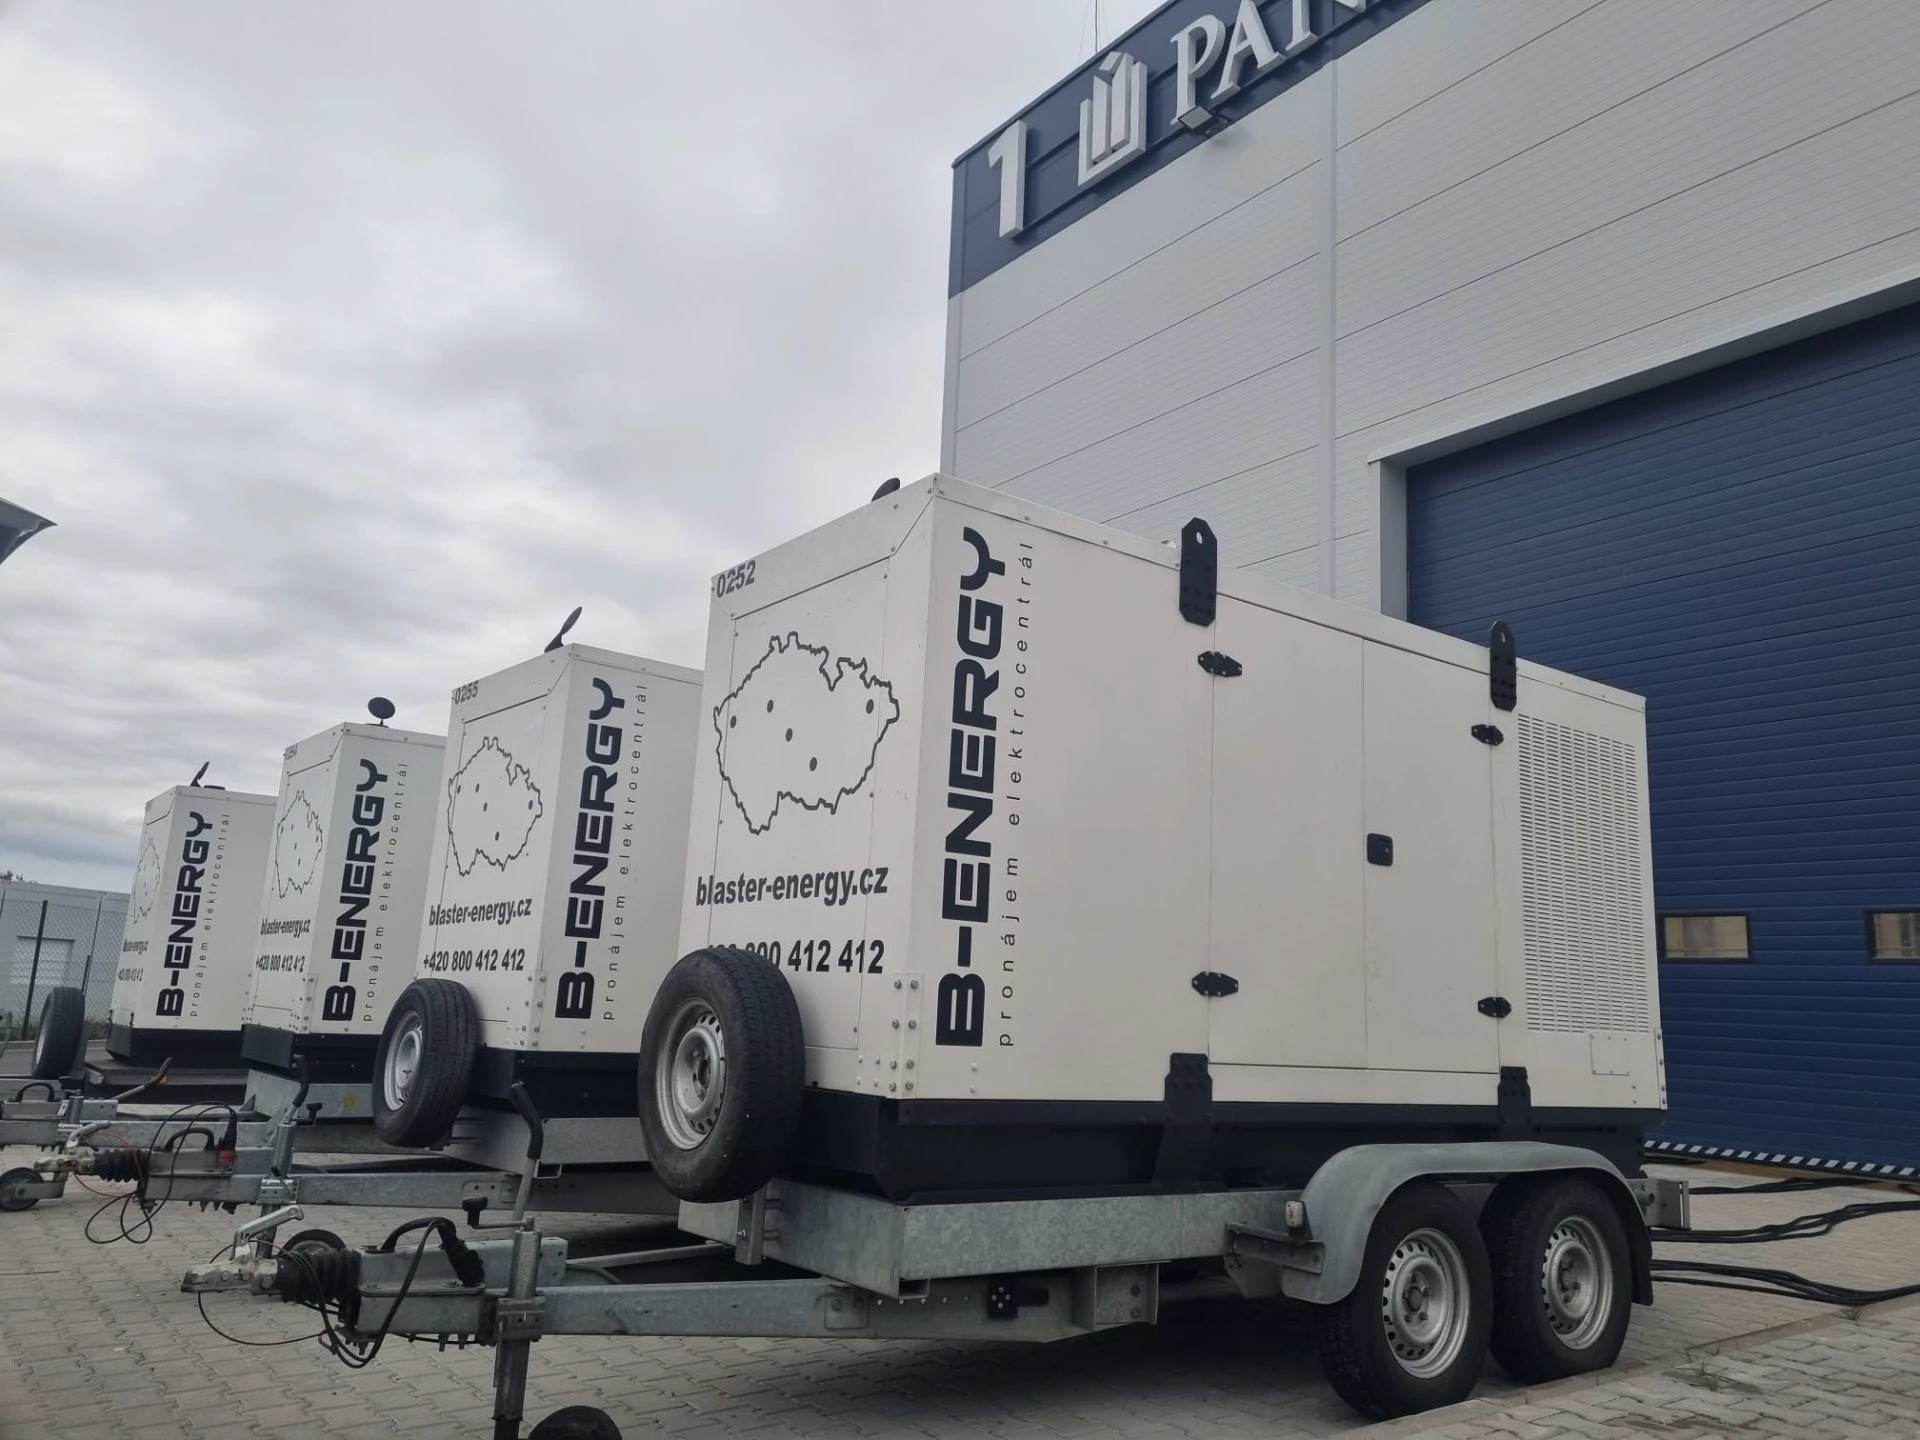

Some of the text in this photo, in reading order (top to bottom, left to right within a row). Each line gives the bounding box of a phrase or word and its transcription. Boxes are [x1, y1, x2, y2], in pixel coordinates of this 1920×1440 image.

[716, 559, 756, 598] 0252
[322, 758, 388, 1021] B-ENERGY
[364, 763, 408, 1022] pronájem elektrocentrál
[555, 677, 625, 1020] B-ENERGY
[604, 685, 648, 1021] pronájem elektrocentrál
[696, 867, 889, 907] blaster-energy.cz
[936, 527, 1006, 1047] B-ENERGY
[1000, 542, 1033, 1047] pronájem elektrocentrál
[156, 811, 213, 1017] B-ENERGY
[423, 948, 525, 971] +420 800 412 412
[429, 898, 532, 926] blaster-energy.cz
[787, 939, 832, 972] 412
[838, 939, 885, 974] 412
